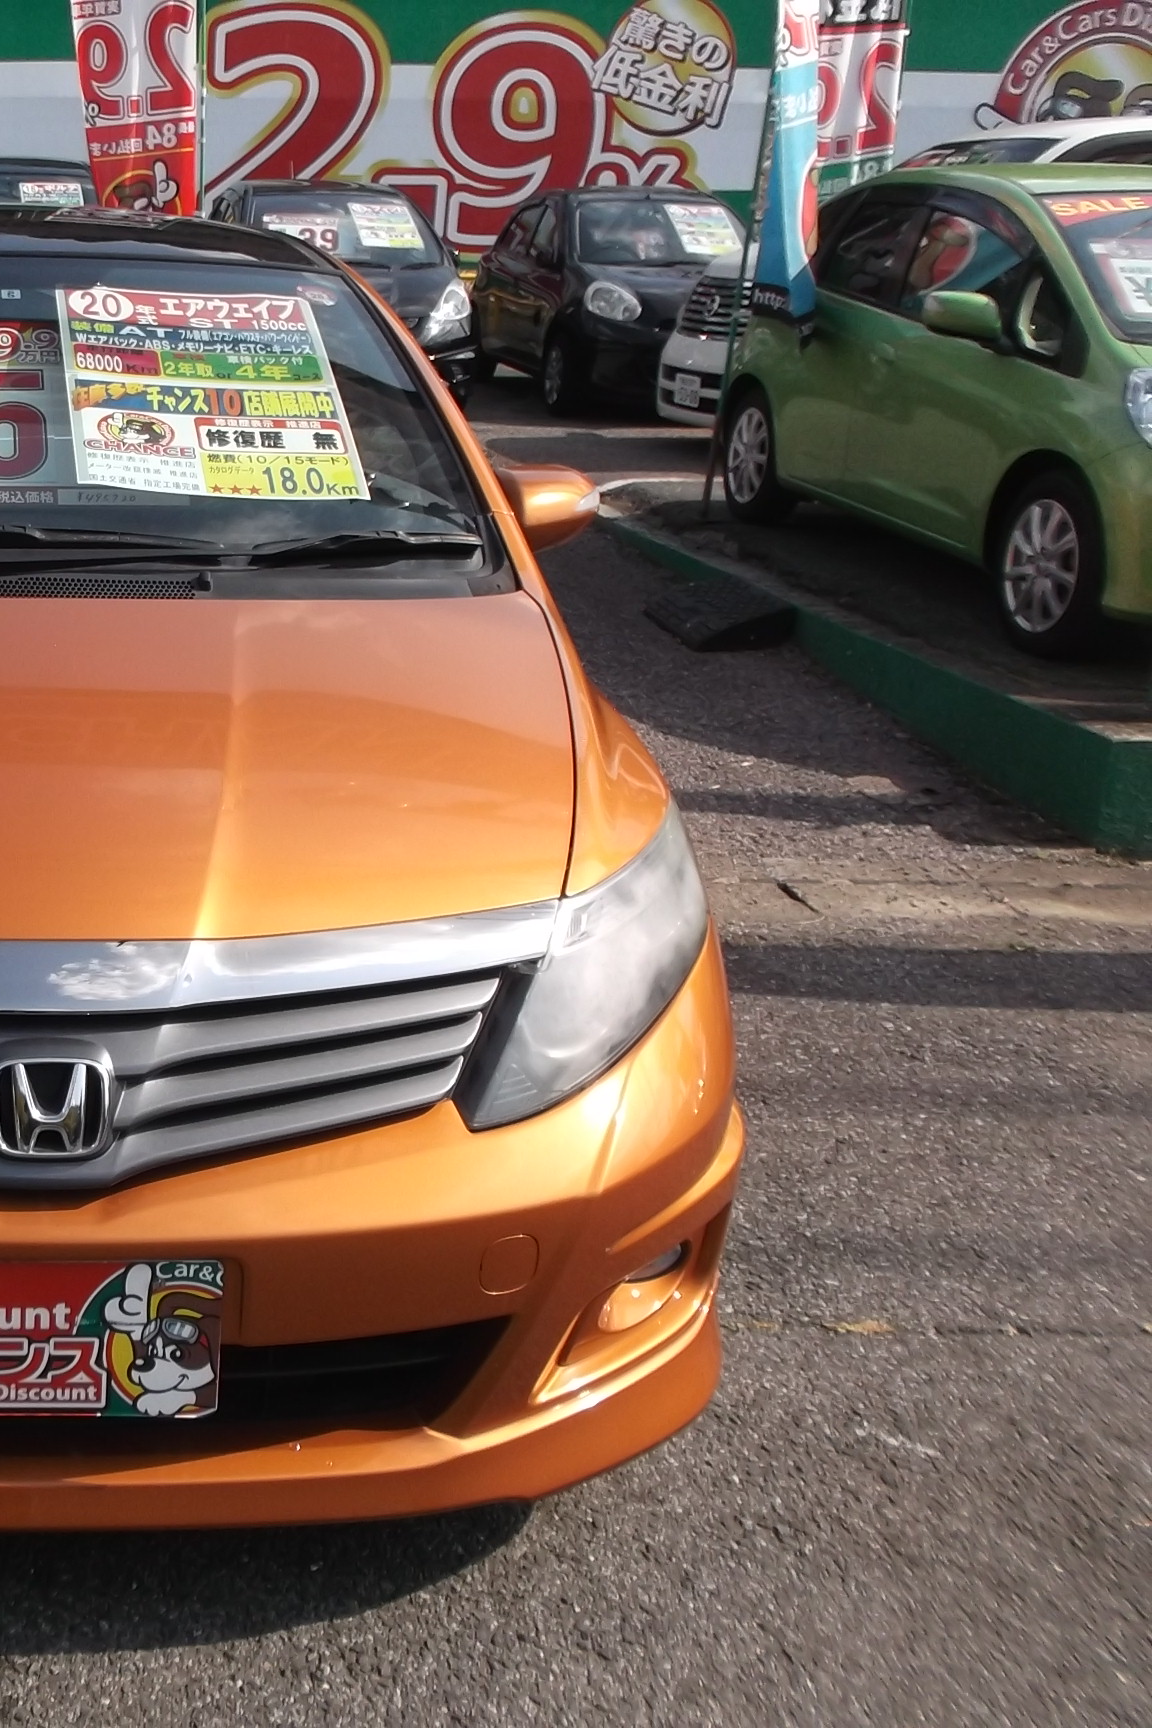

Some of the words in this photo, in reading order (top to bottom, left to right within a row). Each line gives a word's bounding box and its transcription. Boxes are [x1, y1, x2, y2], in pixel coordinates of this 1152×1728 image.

[620, 8, 730, 71] 驚きの
[591, 46, 732, 129] 低金利
[1050, 197, 1151, 216] SALE
[79, 290, 123, 319] 20
[118, 325, 174, 338] AT
[188, 317, 239, 330] ST
[251, 319, 308, 331] 1500cc
[76, 351, 123, 373] 68000
[83, 439, 196, 460] CHANCE
[205, 428, 287, 450] 修復歴
[312, 431, 340, 451] 無
[262, 466, 324, 496] 18.0
[326, 484, 359, 497] Km
[156, 1260, 225, 1287] Car&
